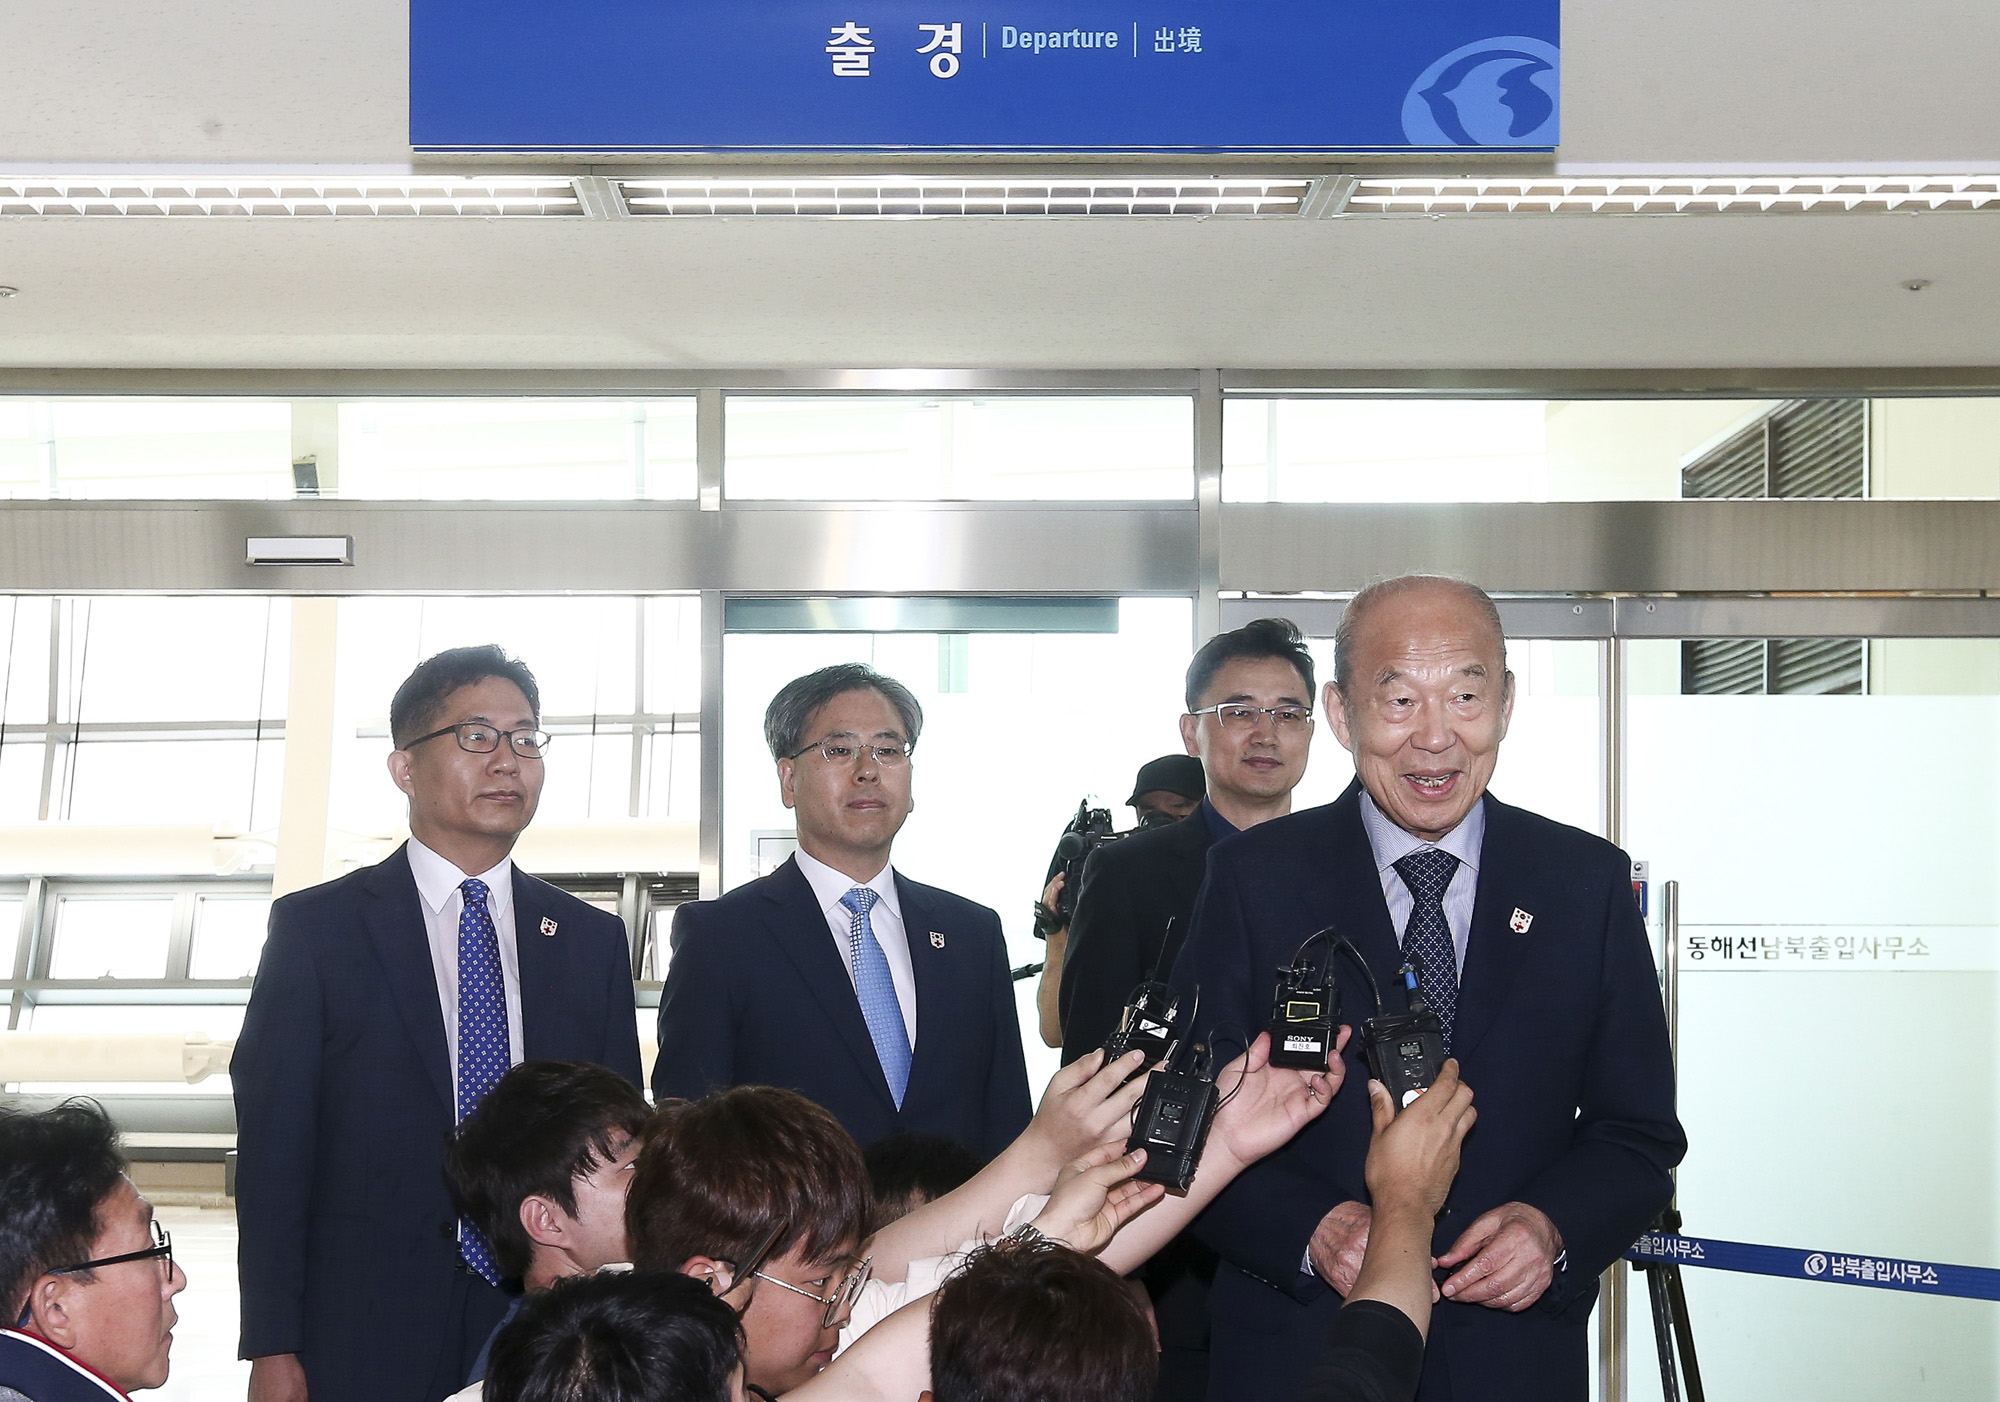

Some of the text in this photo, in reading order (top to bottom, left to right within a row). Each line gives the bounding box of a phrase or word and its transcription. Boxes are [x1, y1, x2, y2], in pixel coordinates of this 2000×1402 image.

[1001, 26, 1119, 54] Departure
[1154, 26, 1203, 53] 出境
[1686, 936, 1930, 960] 동해선남북출입사무소
[1831, 1256, 1939, 1285] 남북출입사무소
